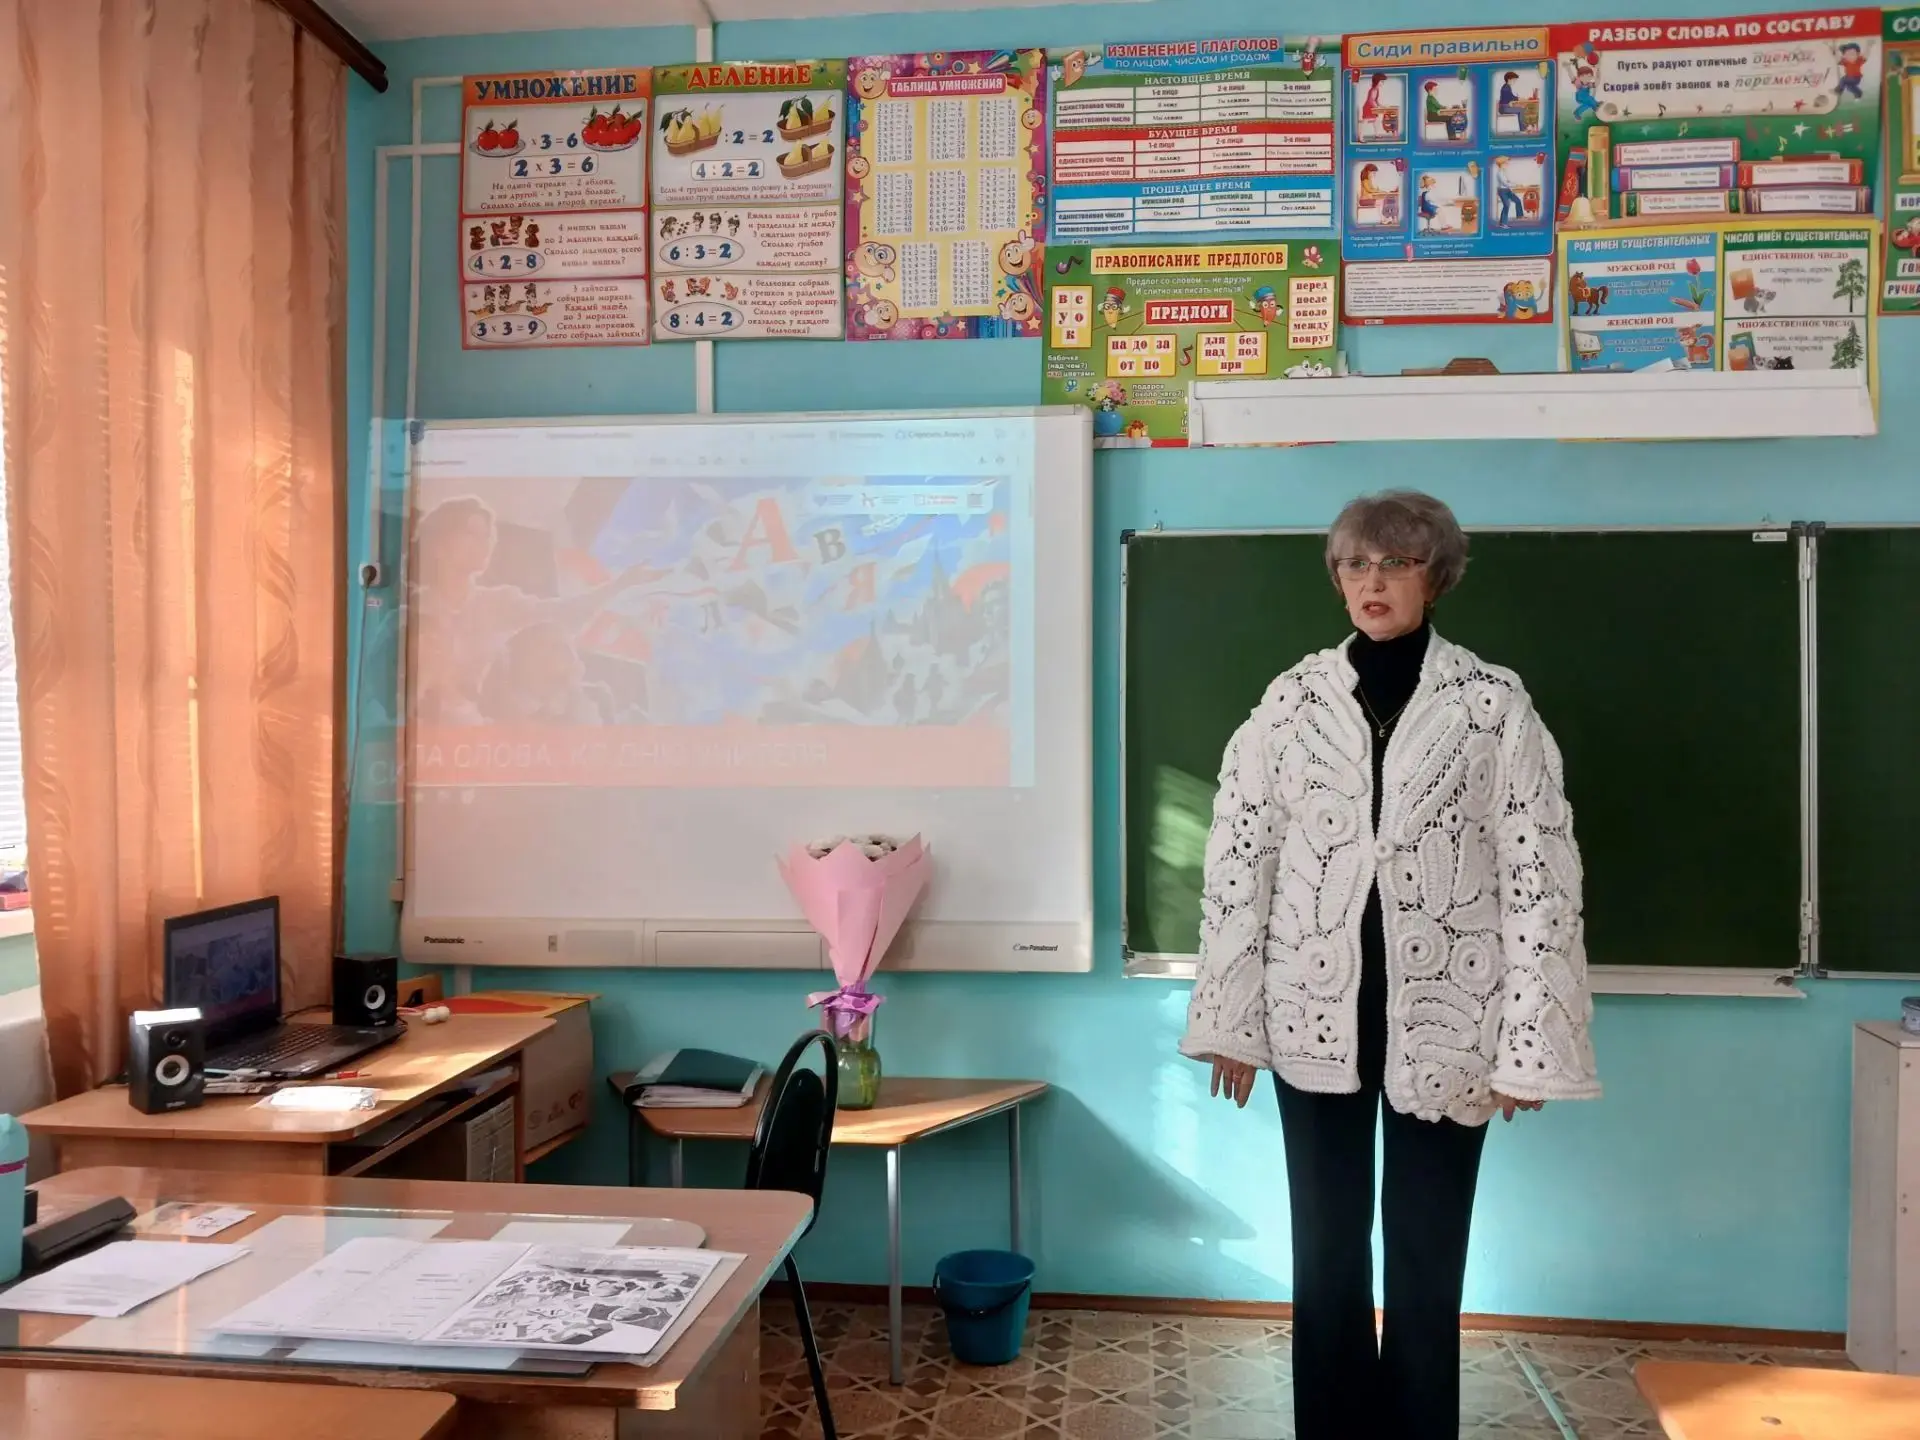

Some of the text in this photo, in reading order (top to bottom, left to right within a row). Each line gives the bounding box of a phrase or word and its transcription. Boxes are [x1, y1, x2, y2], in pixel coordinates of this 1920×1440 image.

[1589, 15, 1855, 42] РАЗБОР СЛОВА ПО СОСТАВУ
[1107, 39, 1279, 57] ИЗМЕНЕНИЕ ГЛАГОЛОВ
[1357, 39, 1539, 64] Сиди правильно
[1617, 61, 1648, 71] Пусть
[1652, 60, 1692, 70] радуют
[1696, 57, 1747, 67] отличные
[687, 65, 811, 90] ДЕЛЕНИЕ
[1145, 71, 1250, 85] НАСТОЯЩЕЕ ВРЕМЯ
[475, 74, 637, 100] УМНОЖЕНИЕ
[891, 79, 1003, 92] ТАБЛИЦА УМНОЖЕНИЯ
[1603, 82, 1639, 93] Скорей
[1643, 81, 1672, 90] зовёт
[1676, 81, 1711, 89] звонок
[732, 131, 744, 144] 2
[762, 130, 774, 143] 2
[1148, 126, 1238, 138] БУДУЩЕЕ ВРЕМЯ
[540, 134, 552, 150] 3
[567, 133, 578, 148] 6
[514, 159, 528, 176] 2
[549, 158, 562, 175] 3
[582, 156, 594, 173] 6
[696, 163, 706, 178] 4
[722, 162, 733, 177] 2
[748, 162, 759, 176] 2
[1142, 181, 1251, 194] ПРОШЕДШЕЕ ВРЕМЯ
[1574, 242, 1591, 252] РОД
[1622, 235, 1710, 249] СУЩЕСТВИТЕЛЬНЫХ
[1725, 231, 1868, 243] ЧИСЛО ИМЁН СУЩЕСТВИТЕЛЬНЫХ
[670, 247, 680, 260] 6
[695, 245, 705, 259] 3
[719, 243, 731, 258] 2
[1742, 252, 1815, 261] ЕДИНСТВЕННОЕ
[474, 256, 483, 270] 4
[501, 255, 511, 269] 2
[526, 254, 536, 268] 8
[1096, 252, 1283, 268] ПРАВОПИСАНИЕ ПРЕДЛОГОВ
[1607, 262, 1675, 272] МУЖСКОЙ РОД
[1126, 278, 1158, 286] Предлог
[1296, 282, 1327, 293] перед
[1059, 312, 1083, 324] у о
[1152, 304, 1228, 321] ПРЕДЛОГИ
[670, 314, 680, 328] 8
[695, 312, 704, 326] 4
[721, 312, 732, 326] 2
[1607, 318, 1653, 326] ЖЕНСКИЙ
[477, 322, 486, 336] 3
[503, 322, 512, 335] 3
[528, 321, 537, 334] 9
[1294, 322, 1329, 332] между
[1066, 330, 1075, 339] к
[1205, 335, 1257, 345] для без
[1293, 335, 1330, 346] вокруг
[1112, 340, 1169, 350] на до за
[1205, 348, 1258, 357] над под
[1120, 361, 1159, 370] от по
[1220, 361, 1241, 373] при
